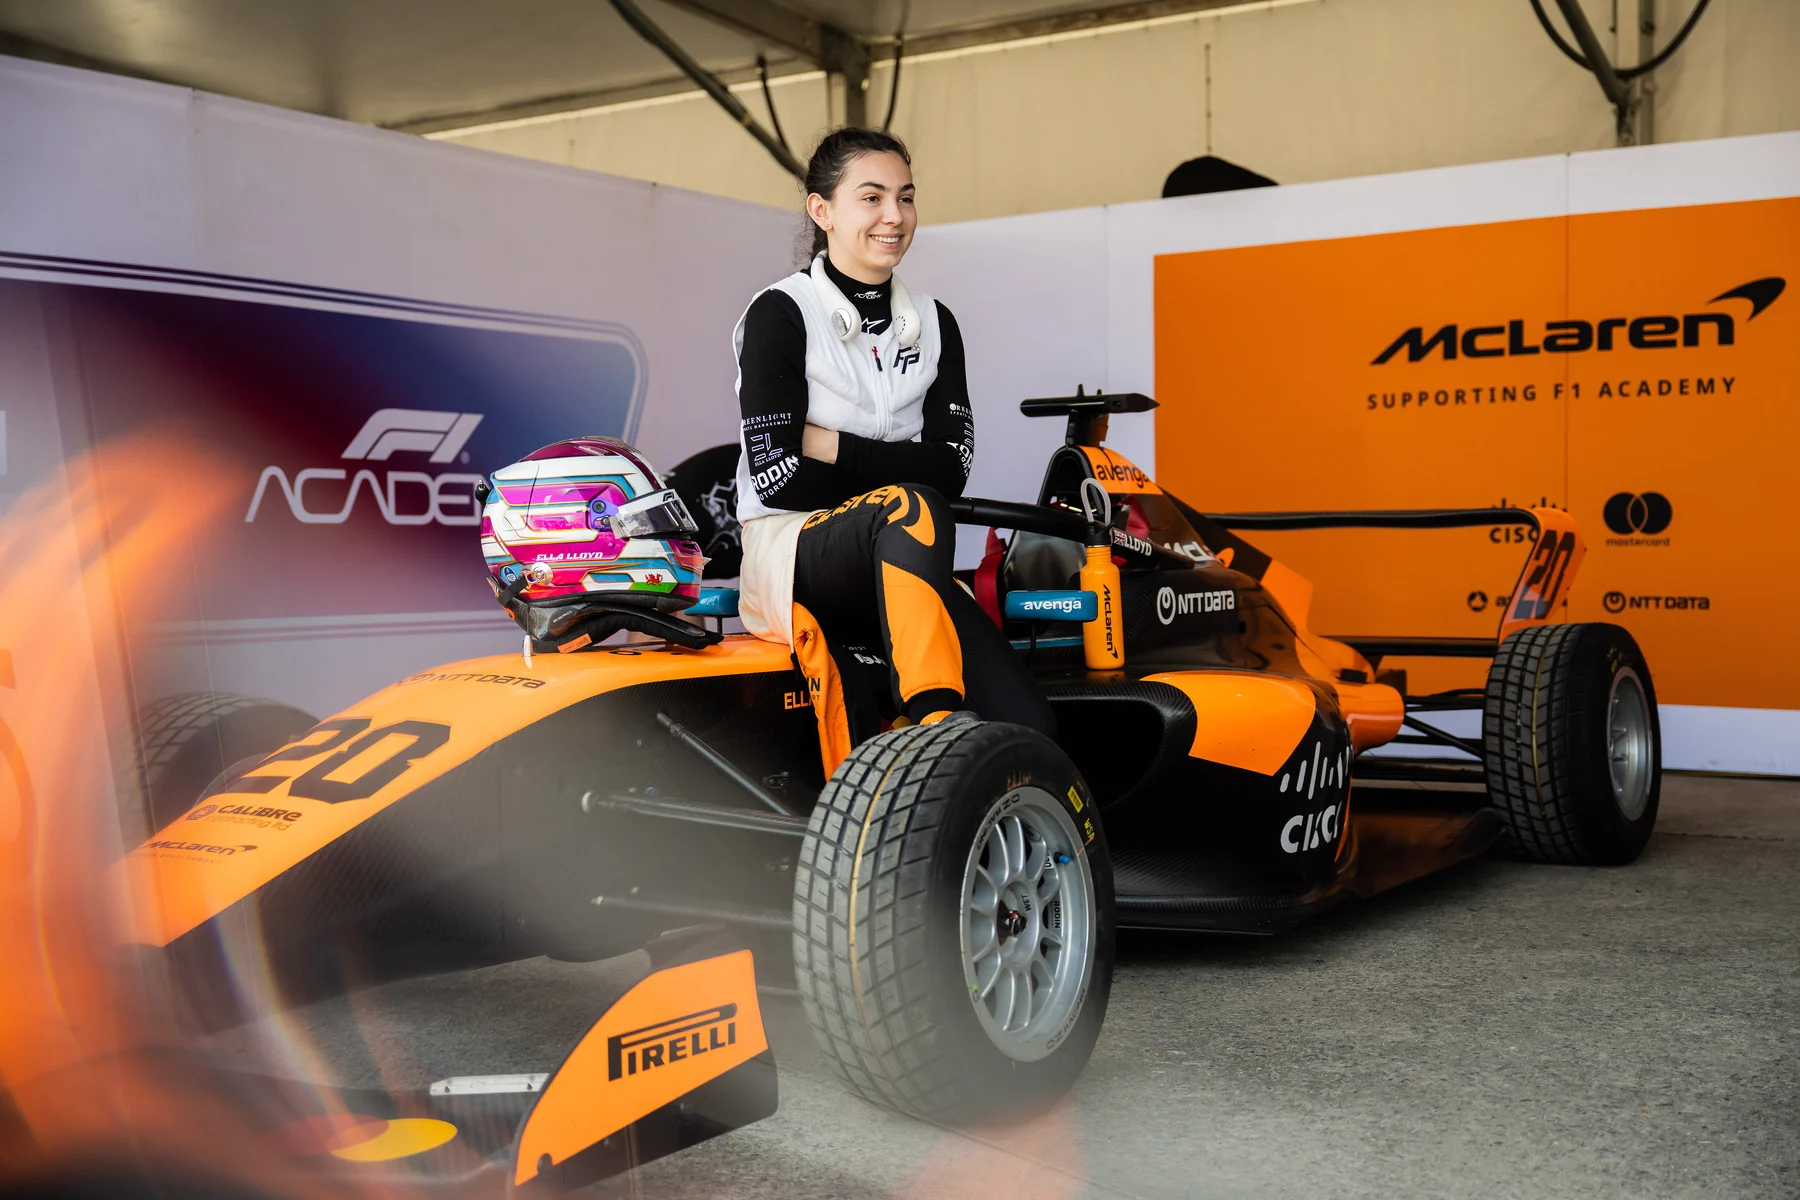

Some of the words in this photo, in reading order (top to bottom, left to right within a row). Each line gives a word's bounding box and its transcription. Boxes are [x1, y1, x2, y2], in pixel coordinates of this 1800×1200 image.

[1370, 312, 1735, 366] McLaren
[1367, 385, 1537, 410] SUPPORTING
[1553, 383, 1581, 399] F1
[1598, 376, 1736, 399] ACADEMY
[743, 413, 792, 426] REENLIGHT
[760, 461, 800, 500] OTORSPORT
[245, 466, 486, 525] ACADE
[1124, 533, 1152, 556] LLOYD
[1490, 527, 1540, 543] CISC
[1606, 537, 1670, 547] mastercard
[566, 552, 603, 560] LLOYD
[1514, 530, 1575, 619] 20
[1024, 598, 1082, 613] avenga
[1178, 593, 1206, 614] NTT
[1630, 596, 1661, 609] NTT
[1103, 584, 1113, 652] McLaren
[235, 718, 451, 804] 20
[206, 815, 271, 829] contracting
[273, 822, 293, 831] ltd
[142, 841, 238, 855] McLaren
[1021, 894, 1031, 912] WET
[608, 1002, 738, 1082] PIRELLI
